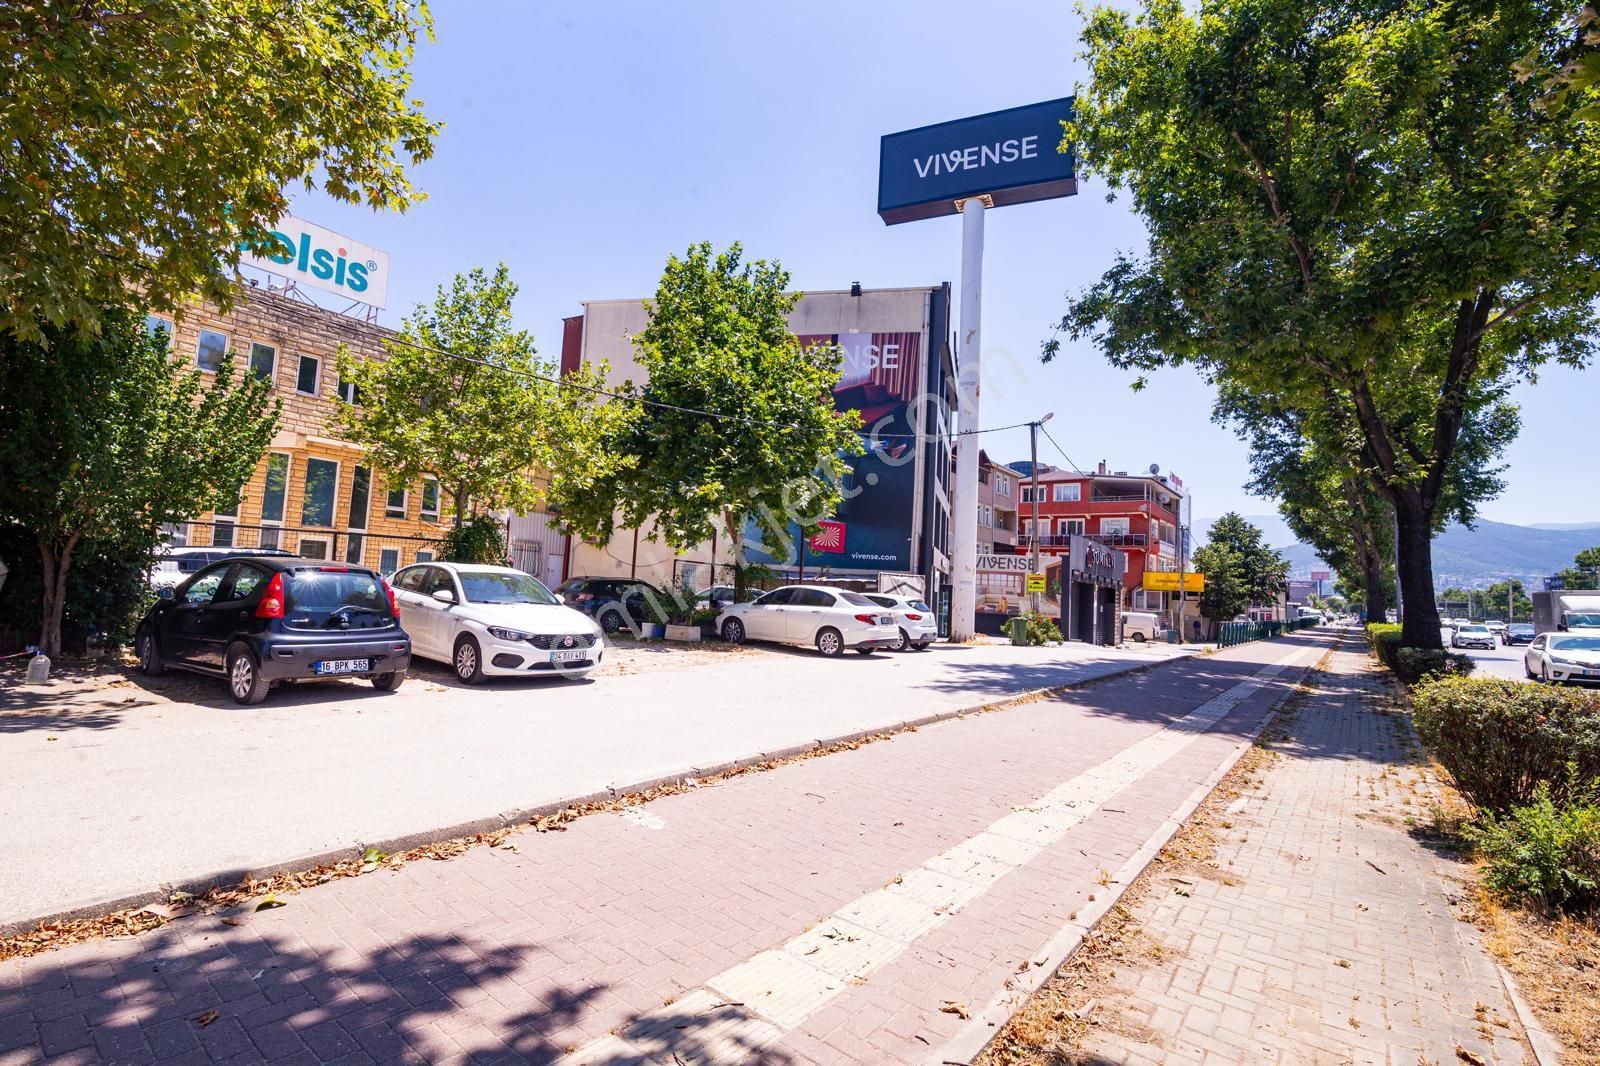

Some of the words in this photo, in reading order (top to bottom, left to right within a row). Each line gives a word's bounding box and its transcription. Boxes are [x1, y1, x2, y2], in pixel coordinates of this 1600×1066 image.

[913, 135, 1038, 178] VIVENSE
[851, 552, 897, 561] vivense.com
[321, 662, 331, 671] 16
[334, 661, 349, 670] BPK
[353, 660, 368, 669] 565
